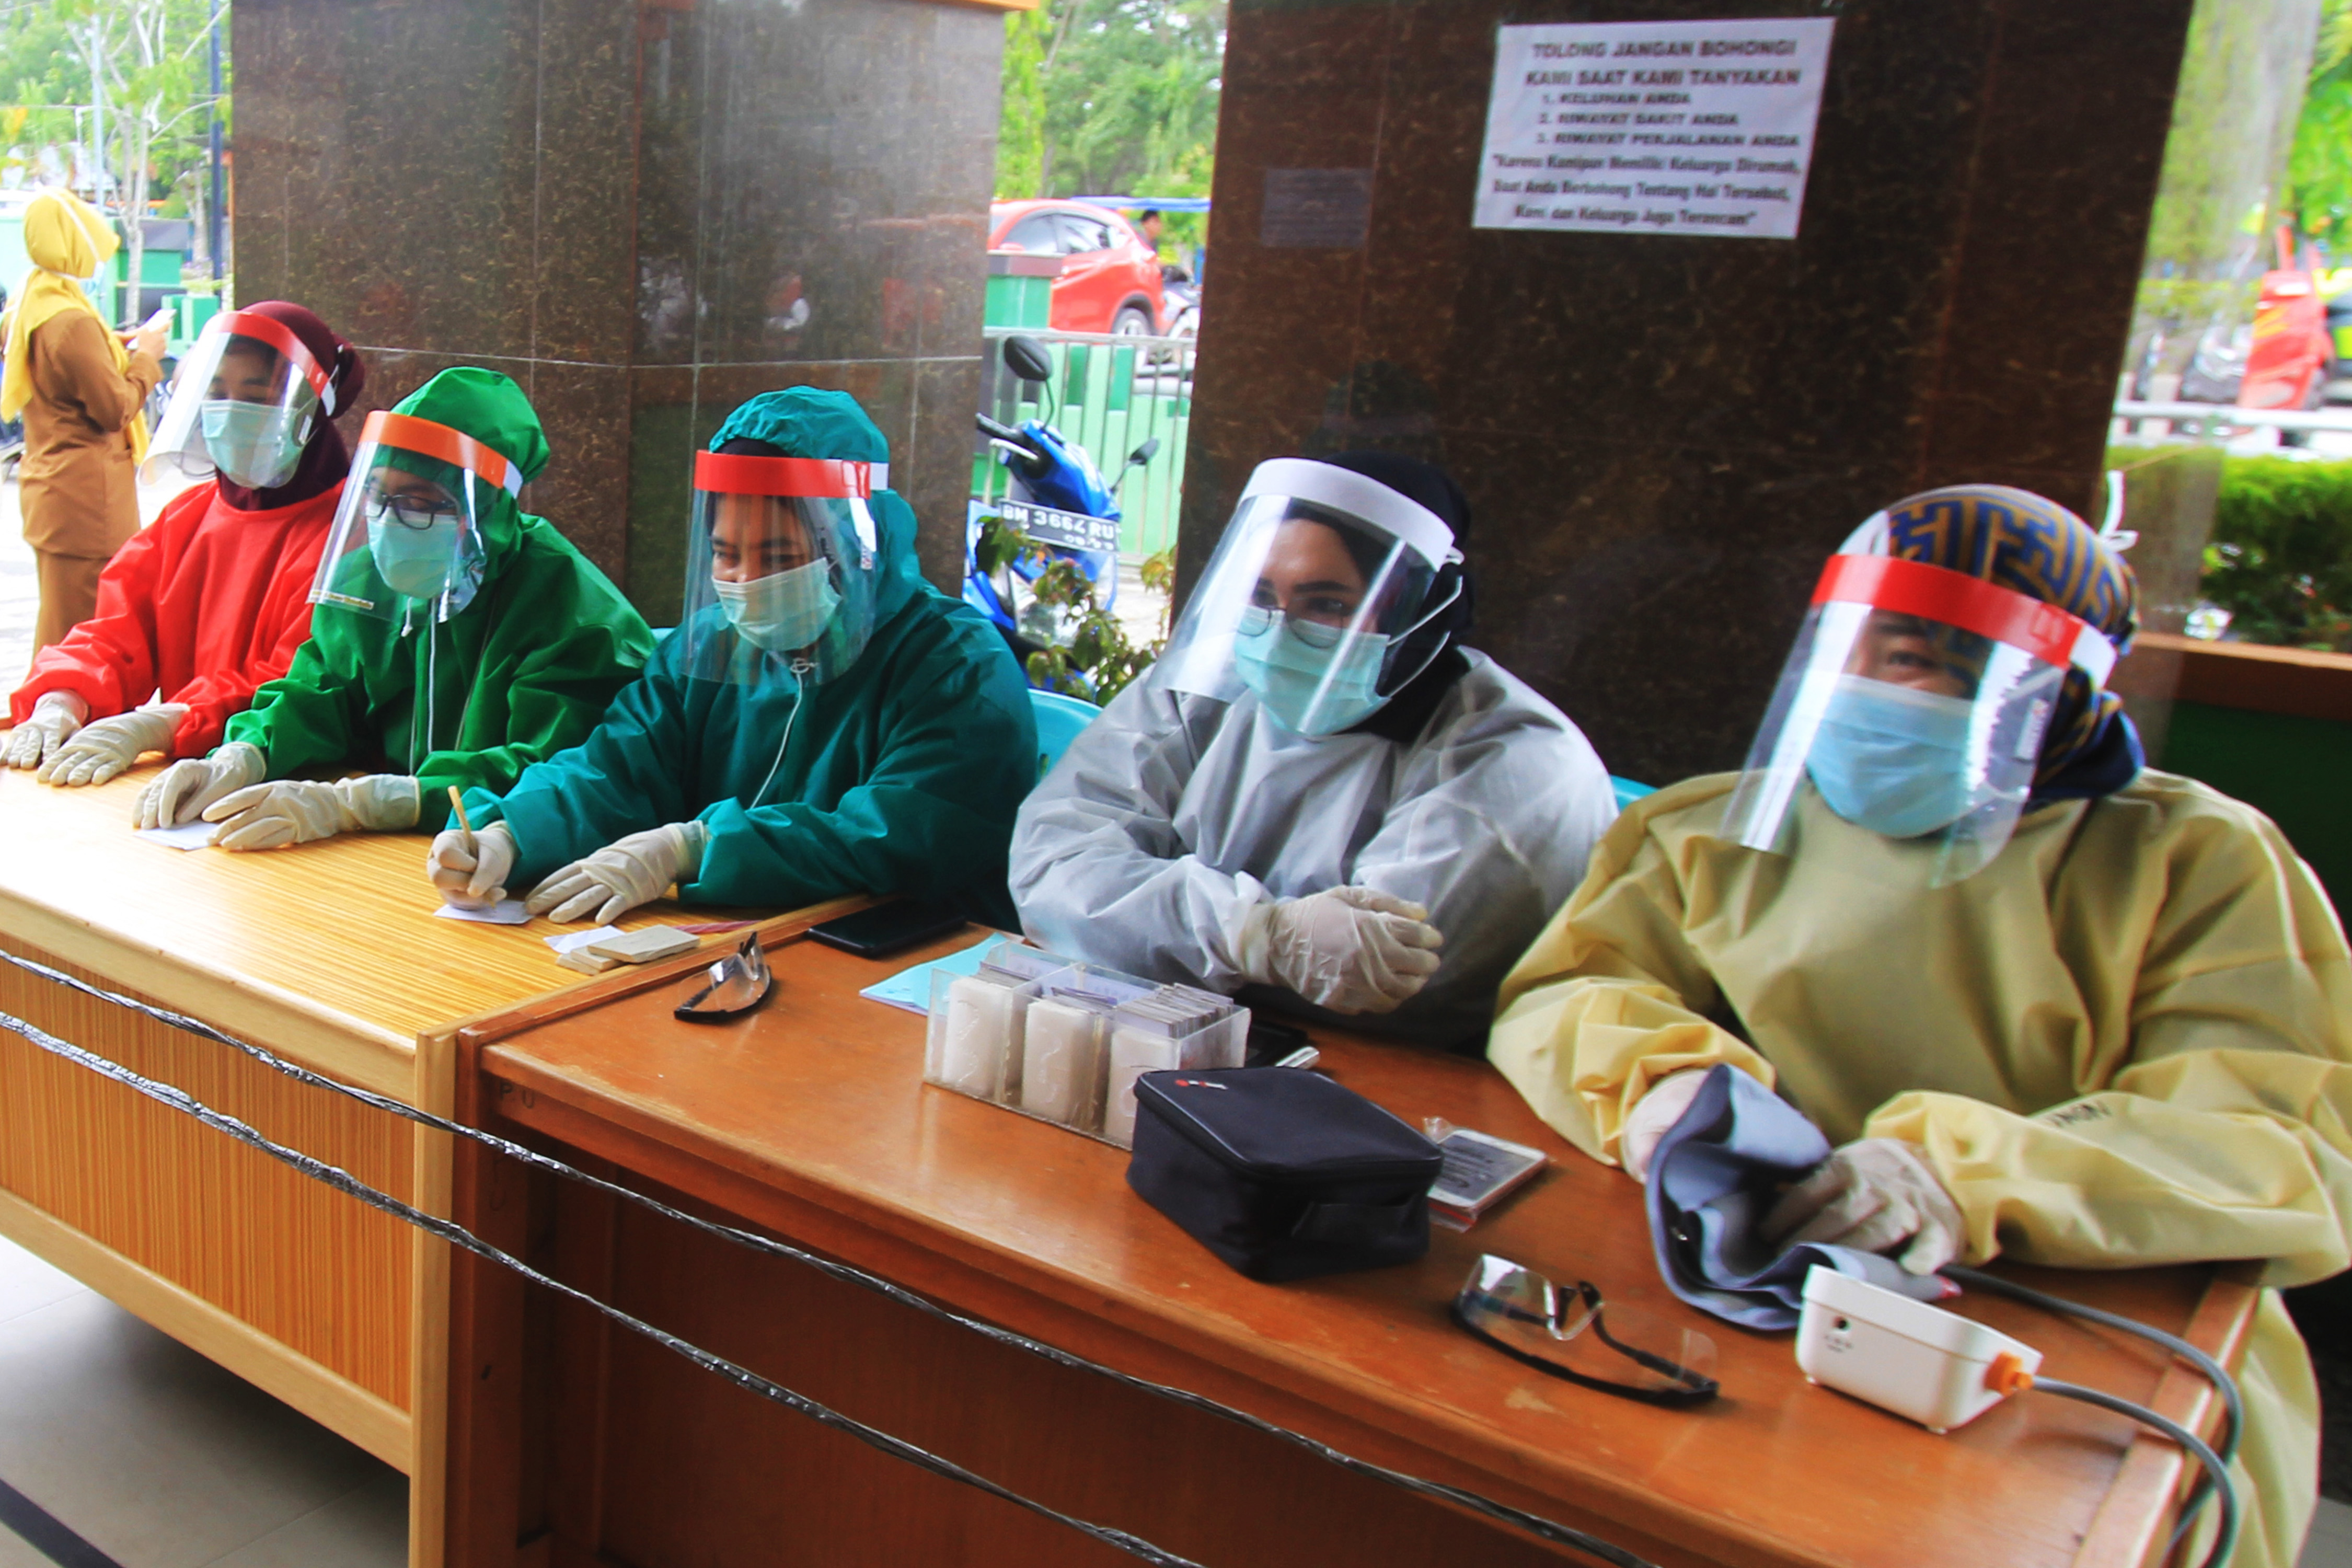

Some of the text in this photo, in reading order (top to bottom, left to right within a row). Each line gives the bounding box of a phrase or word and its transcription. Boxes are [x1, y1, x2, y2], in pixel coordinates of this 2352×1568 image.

[1532, 39, 1797, 57] TOLONG JANGAN BOHONGI
[1526, 68, 1802, 85] KAMI SAAT KAMI TANYAKAN
[1560, 91, 1641, 103] KELUHAN
[1644, 92, 1690, 103] ANDA
[1558, 112, 1629, 124] RIWAYAT
[1635, 113, 1685, 124] SAKIT
[1691, 113, 1738, 125] ANDA
[1554, 133, 1627, 144] RIWAYAT
[1630, 133, 1746, 145] PERJALANAN
[1751, 134, 1800, 146] ANDA
[1670, 157, 1733, 175] Keluarga
[1525, 180, 1558, 193] Anda
[1636, 182, 1690, 201] Tentang
[1551, 207, 1574, 220] dan
[1579, 207, 1640, 225] Keluarga
[1002, 503, 1029, 523] BM
[1089, 521, 1114, 539] RU
